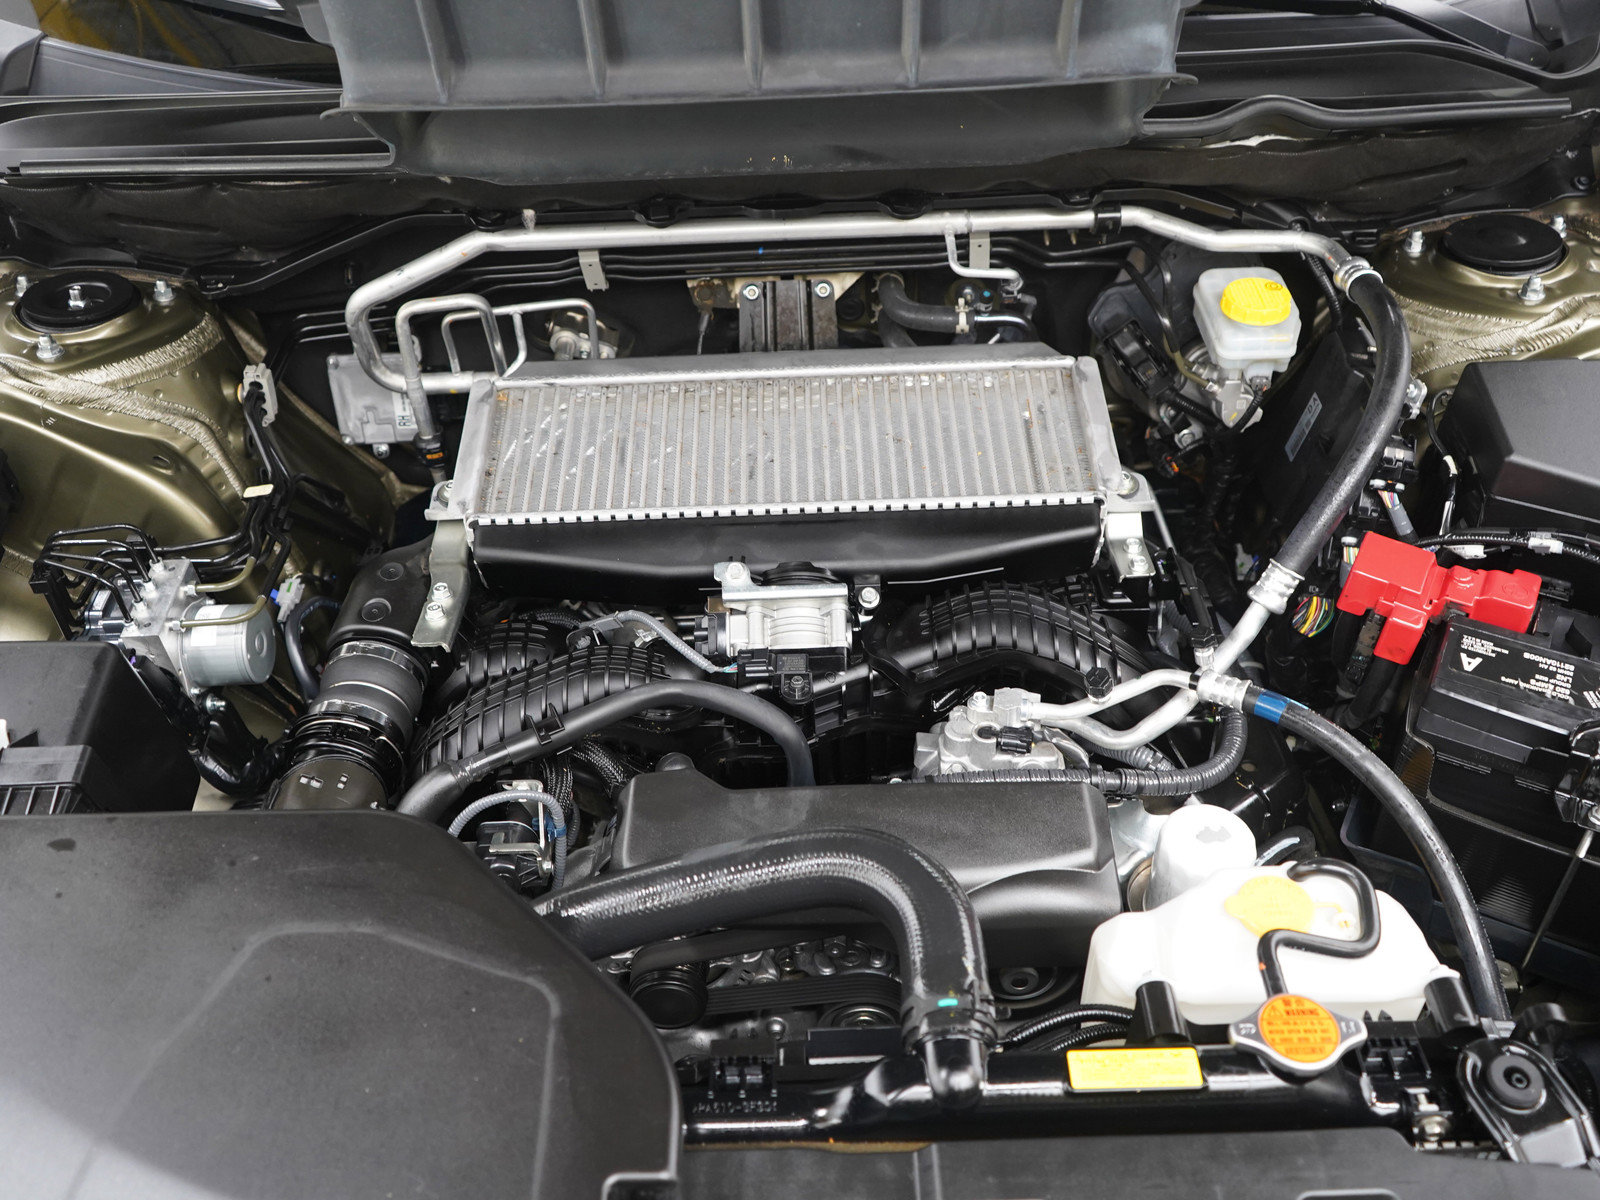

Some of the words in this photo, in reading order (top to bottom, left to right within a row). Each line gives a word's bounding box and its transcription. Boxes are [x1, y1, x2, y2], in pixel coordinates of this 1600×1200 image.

[398, 415, 411, 427] RH
[1501, 676, 1518, 685] AMPS
[1530, 678, 1555, 691] AMPS
[1549, 678, 1572, 689] GROUP
[1284, 1008, 1320, 1017] WARNING
